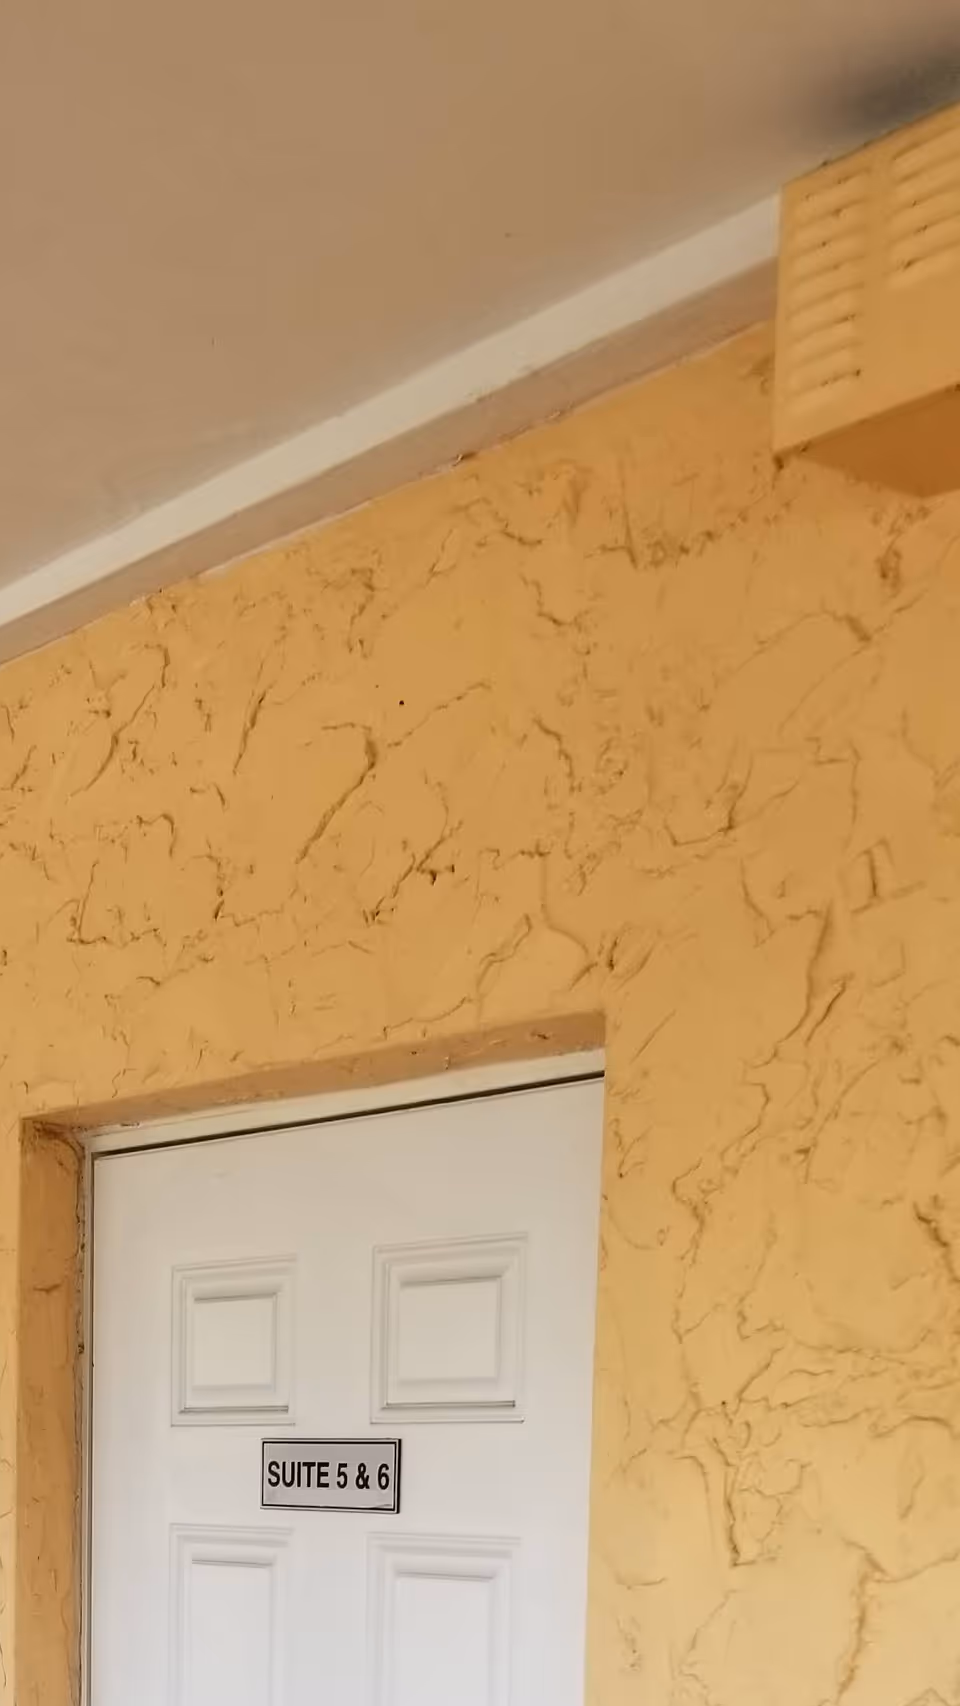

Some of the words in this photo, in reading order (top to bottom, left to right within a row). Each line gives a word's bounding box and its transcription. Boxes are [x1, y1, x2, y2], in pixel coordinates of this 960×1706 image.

[267, 1460, 330, 1488] SUITE
[336, 1462, 348, 1489] 5
[355, 1462, 370, 1489] &
[377, 1463, 390, 1490] 6
